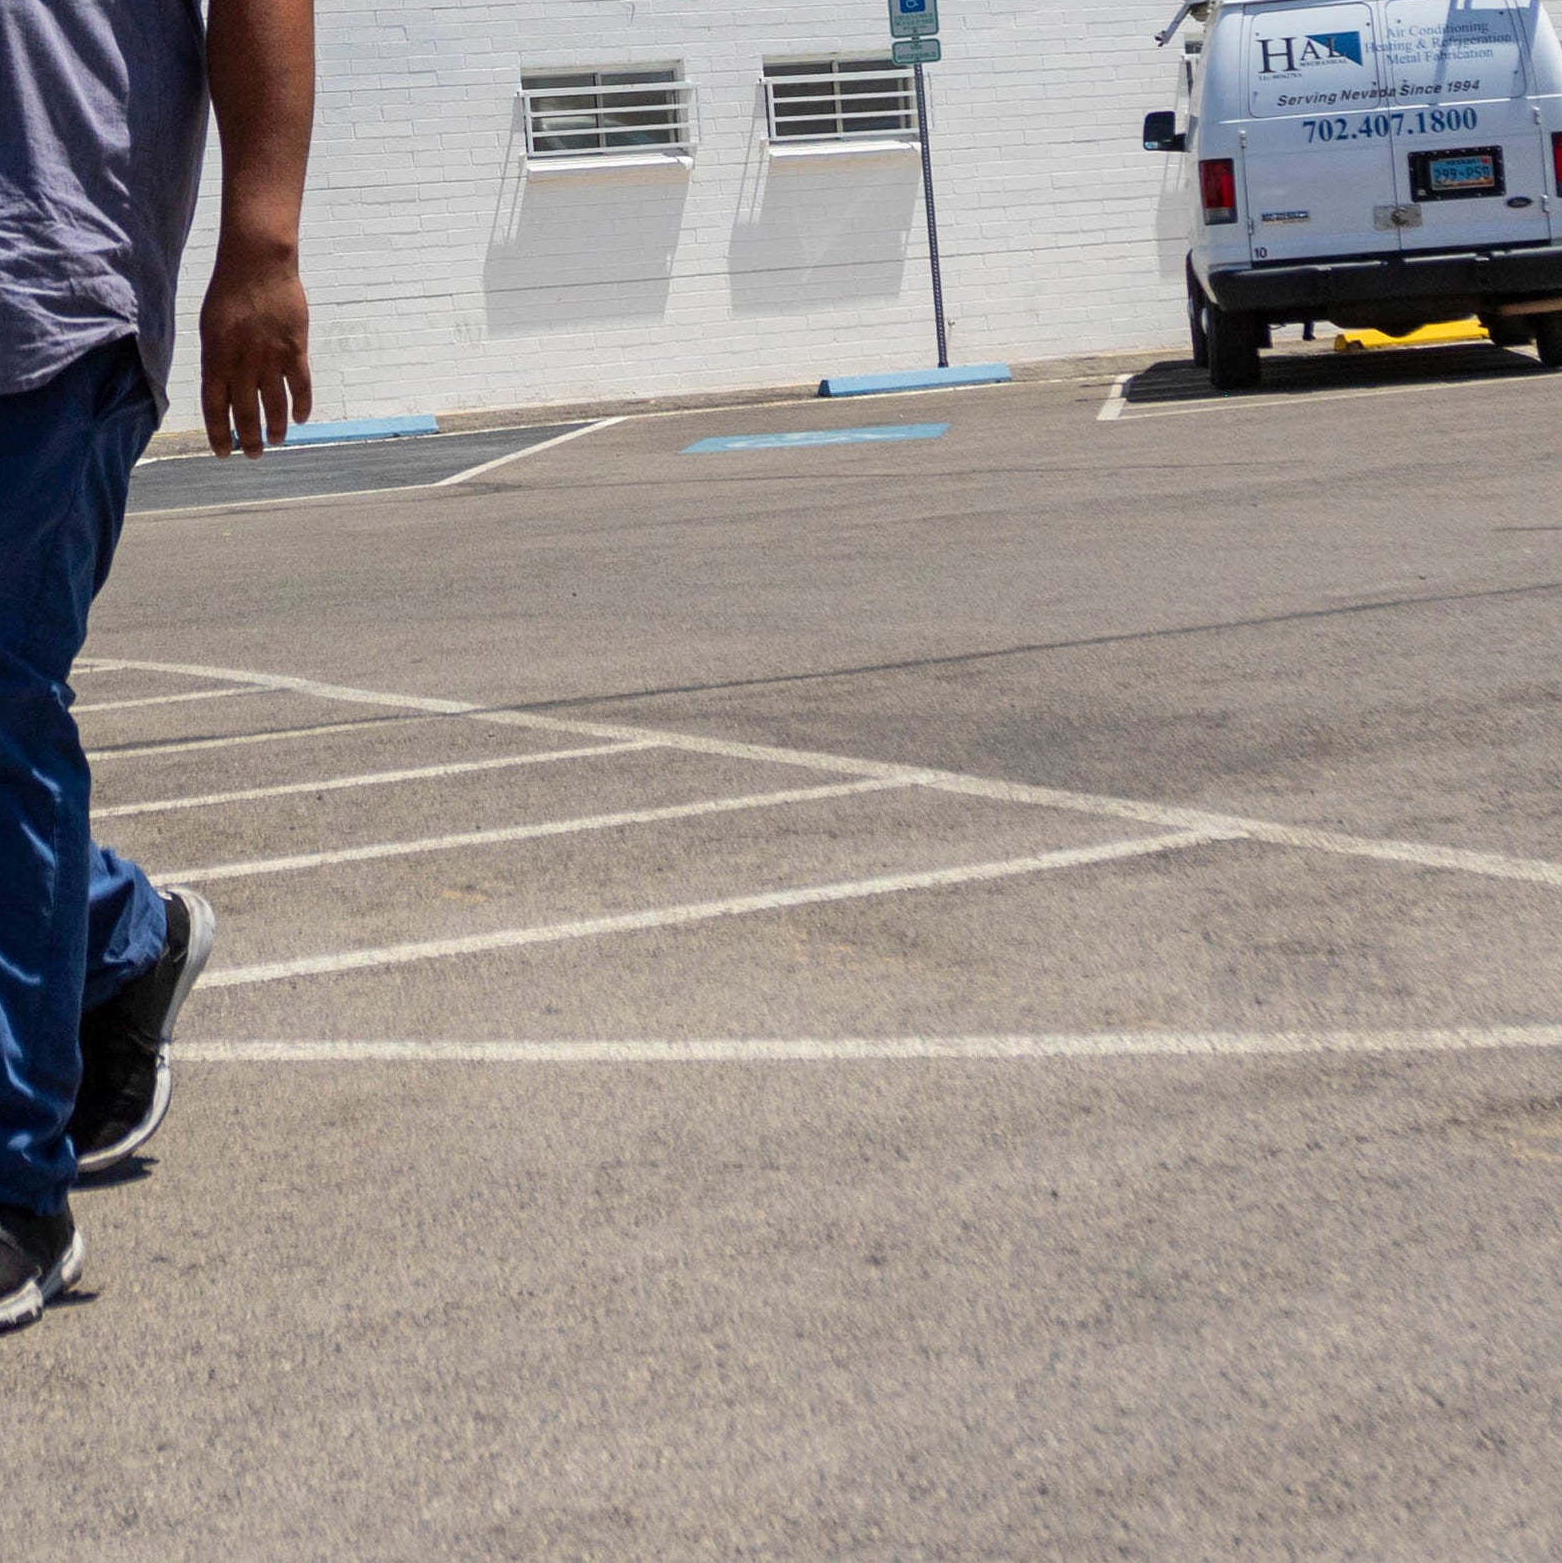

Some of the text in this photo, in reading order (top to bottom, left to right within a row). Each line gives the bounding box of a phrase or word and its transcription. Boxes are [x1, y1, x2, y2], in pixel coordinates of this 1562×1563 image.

[1387, 21, 1489, 38] Air Conditioning
[1365, 33, 1511, 53] Heating & Refrigeration
[1256, 36, 1347, 74] HAL
[1387, 48, 1494, 64] Metal Fabrication
[1277, 80, 1480, 107] Serving Nevada Since 1994
[1302, 107, 1478, 144] 702.407.1800
[1253, 246, 1268, 258] 10
